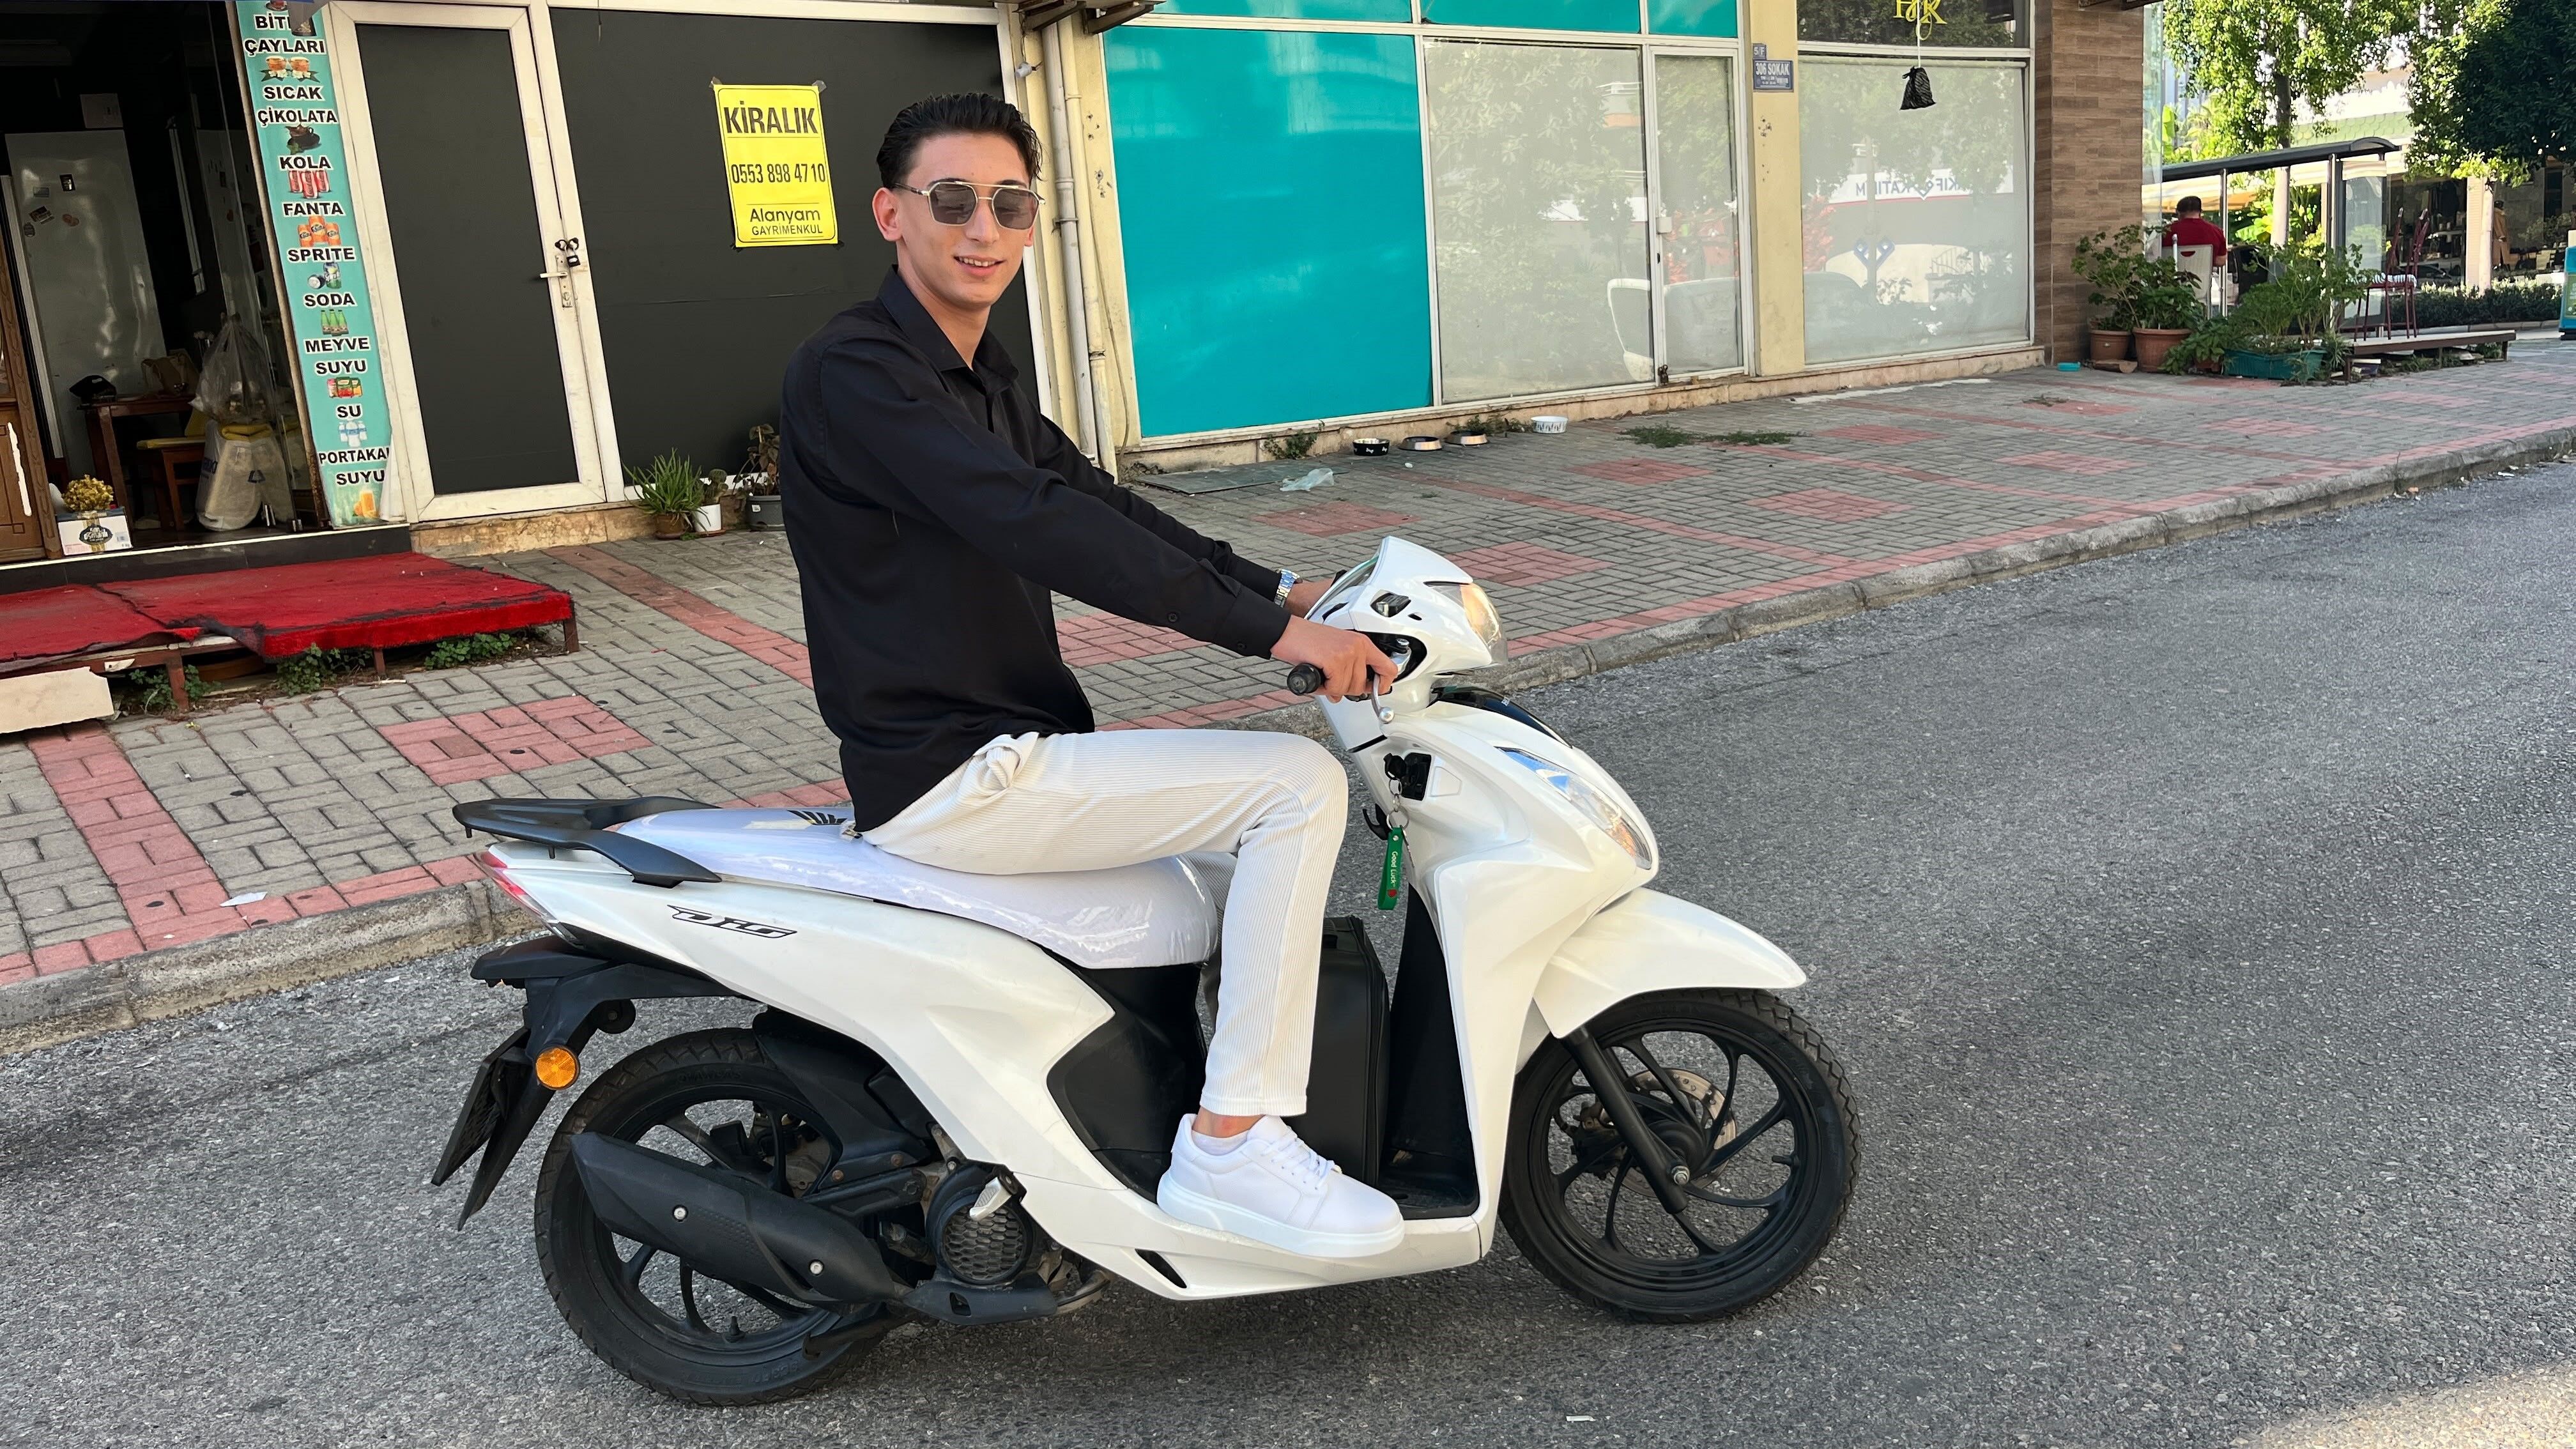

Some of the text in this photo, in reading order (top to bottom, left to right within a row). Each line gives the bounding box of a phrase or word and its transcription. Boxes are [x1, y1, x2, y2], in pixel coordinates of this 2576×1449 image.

[256, 13, 291, 29] BİT
[245, 39, 325, 56] ÇAYLARI
[1756, 63, 1790, 75] 306 SOKAK
[264, 86, 322, 100] SICAK
[257, 107, 337, 125] ÇİKOLATA
[723, 100, 818, 134] KİRALIK
[280, 157, 331, 169] KOLA
[731, 163, 826, 184] 0553 898 4710
[283, 203, 344, 216] FANTA
[750, 208, 820, 224] Alanyam
[288, 248, 355, 262] SPRITE
[304, 293, 355, 307] SODA
[305, 337, 369, 353] MEYVE
[316, 360, 366, 374] SUYU
[337, 405, 361, 418] SU
[336, 470, 385, 486] SUYU
